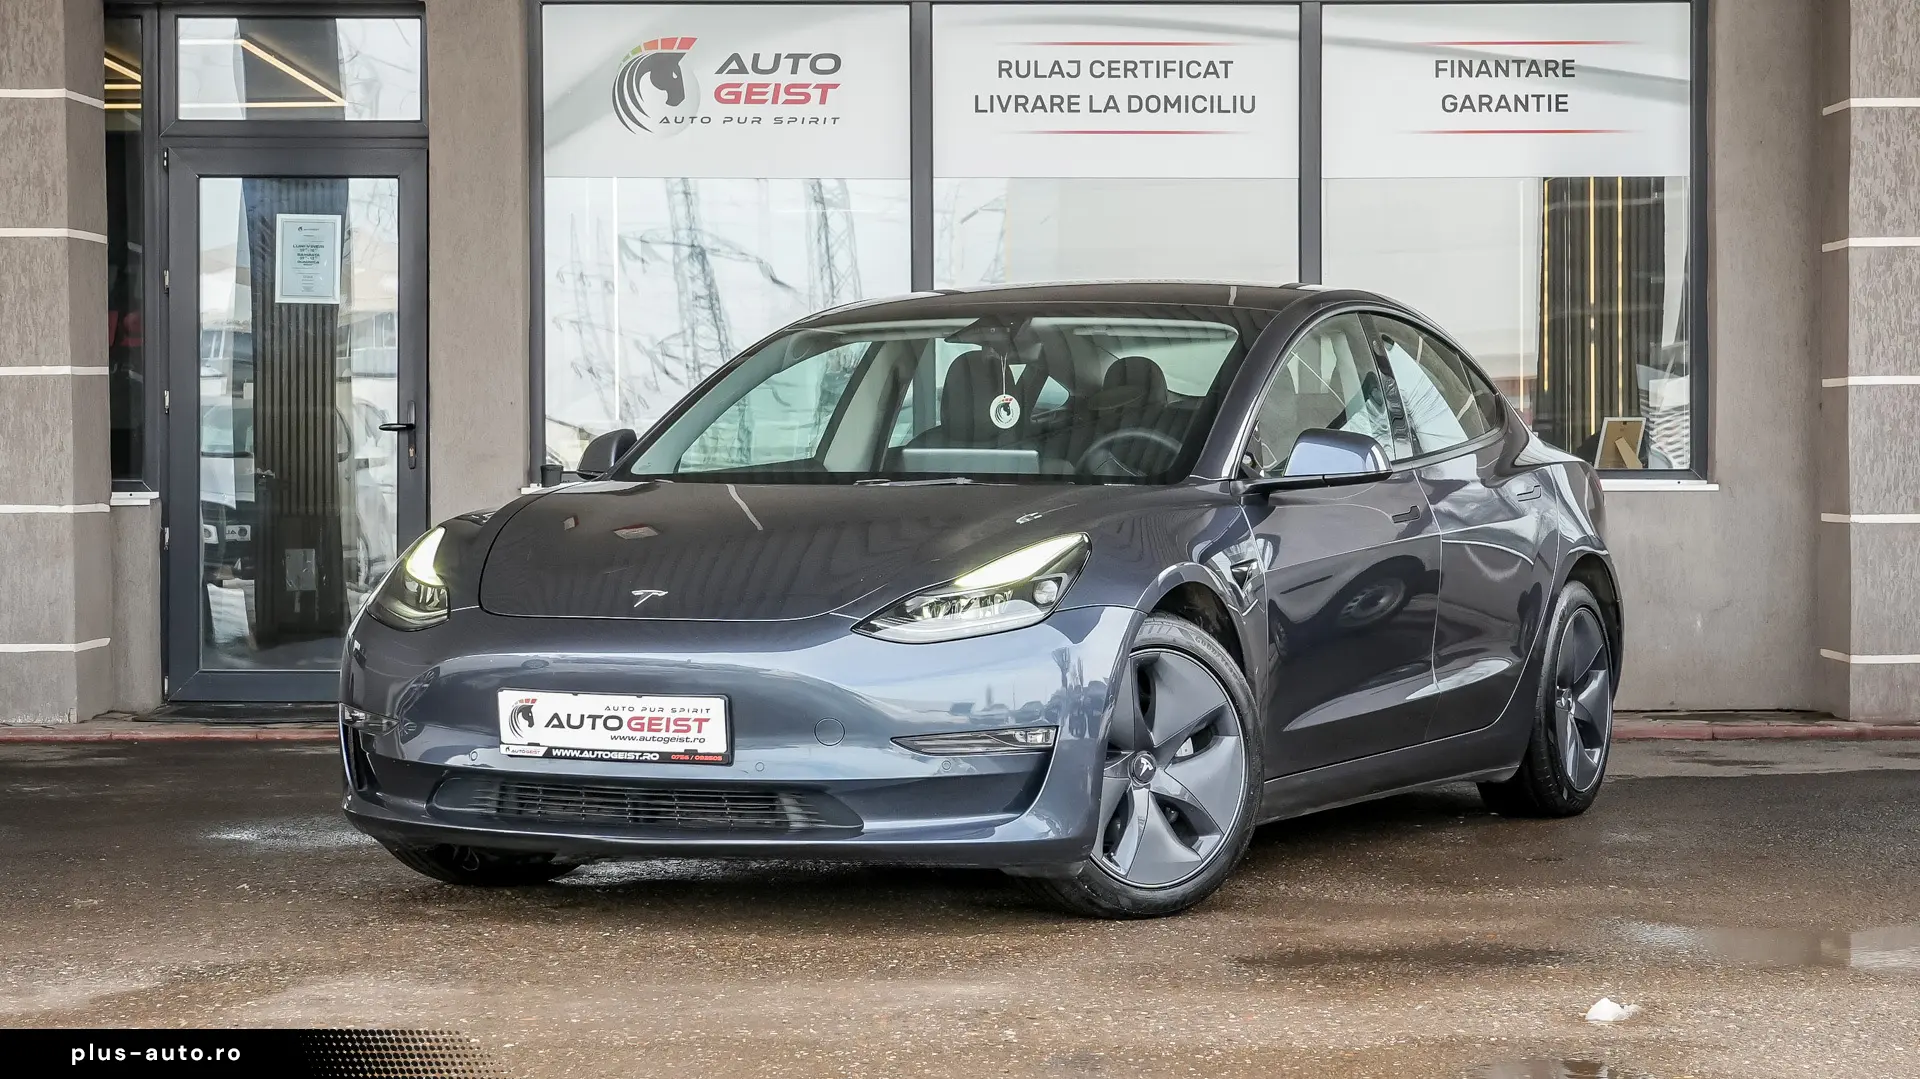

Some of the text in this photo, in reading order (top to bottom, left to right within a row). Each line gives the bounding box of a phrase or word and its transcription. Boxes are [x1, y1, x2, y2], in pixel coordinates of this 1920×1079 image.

[714, 52, 842, 75] AUTO
[998, 60, 1234, 79] RULAJ CERTIFICAT
[1435, 59, 1576, 78] FINANTARE
[714, 82, 841, 105] GEIST
[974, 94, 1256, 114] LIVRARE LA DOMICILIU
[1441, 94, 1569, 113] GARANTIE
[659, 116, 841, 125] AUTO PUR SPIRIT
[610, 735, 706, 744] www.autogeist.ro
[552, 748, 660, 761] WWW.AUTOGEIST.RO
